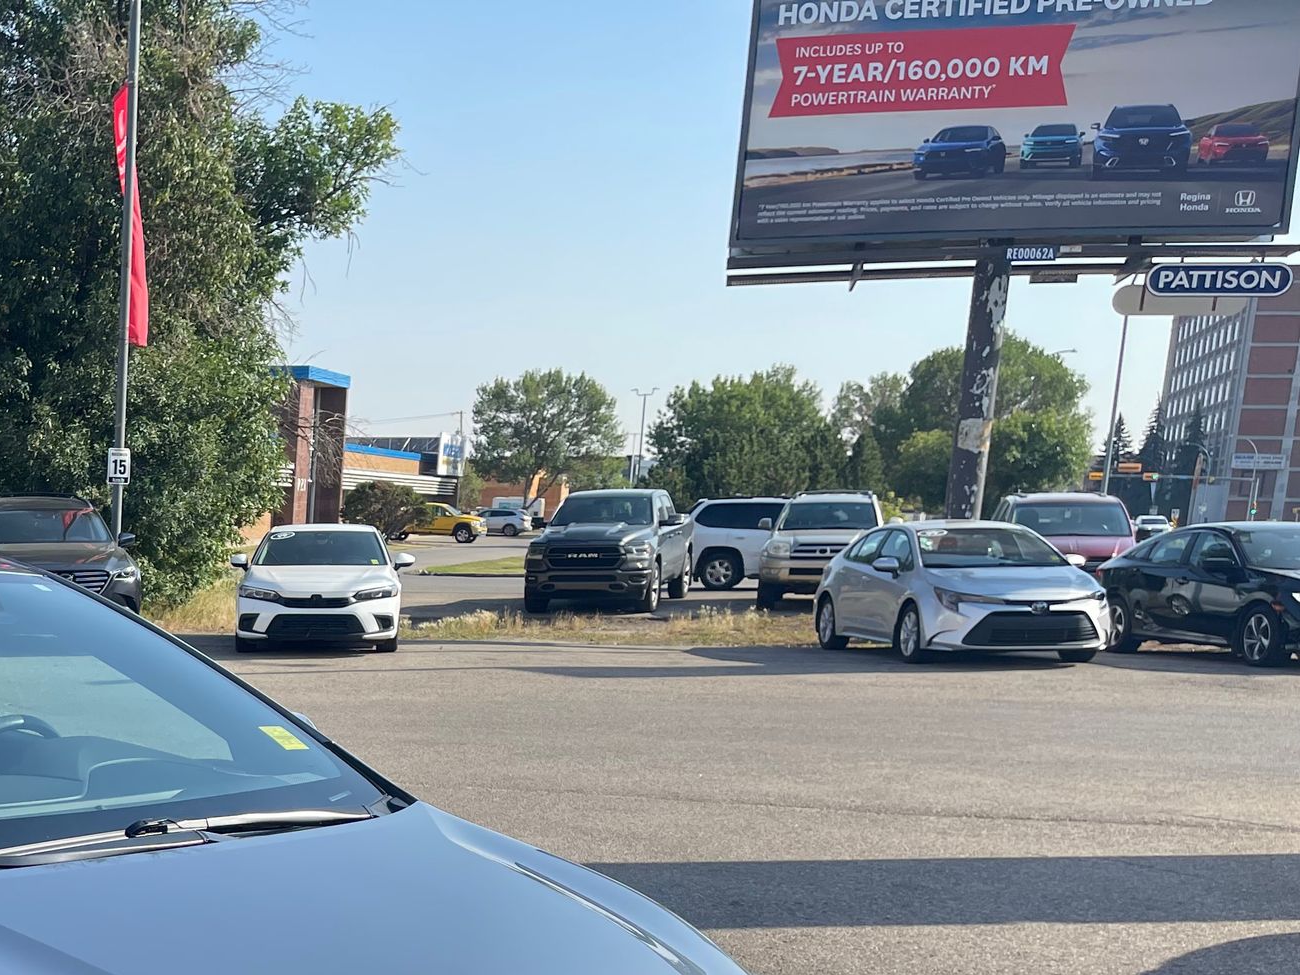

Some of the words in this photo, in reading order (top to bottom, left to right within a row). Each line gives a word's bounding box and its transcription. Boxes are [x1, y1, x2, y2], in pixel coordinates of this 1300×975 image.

[778, 0, 878, 26] HONDA
[884, 0, 1030, 20] CERTIFIED
[1037, 0, 1212, 13] PRE-O
[796, 44, 862, 58] INCLUDES
[865, 42, 884, 54] UP
[886, 42, 904, 54] TO
[793, 57, 1000, 86] 7-YEAR/160,000
[1008, 55, 1049, 76] KM
[790, 90, 896, 107] POWERTRAIN
[1180, 192, 1211, 202] Regina
[1179, 203, 1209, 211] Honda
[1006, 248, 1054, 260] RE00062A
[1158, 270, 1282, 289] PATTISON
[112, 459, 126, 475] 15
